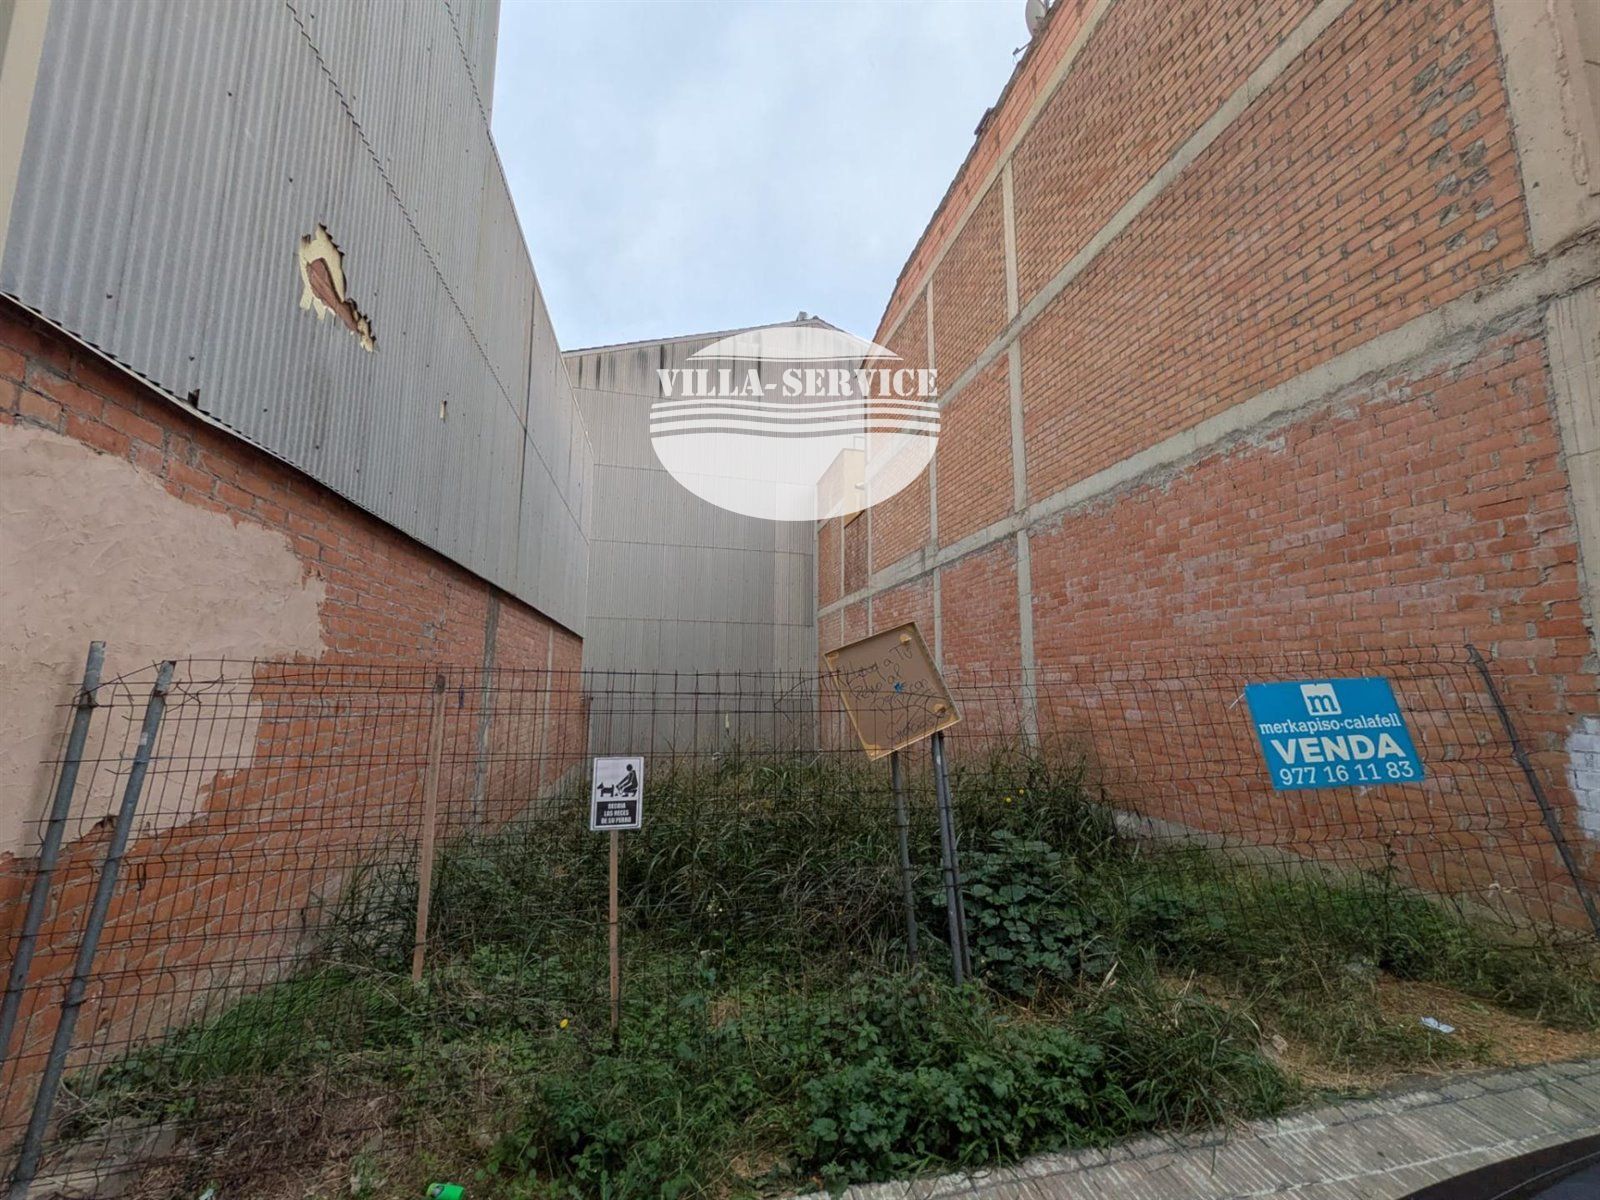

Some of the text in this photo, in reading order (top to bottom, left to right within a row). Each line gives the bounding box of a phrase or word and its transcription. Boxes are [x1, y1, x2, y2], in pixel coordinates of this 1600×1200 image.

[1270, 733, 1407, 765] VENDA
[1279, 760, 1414, 785] 977 16 11 83
